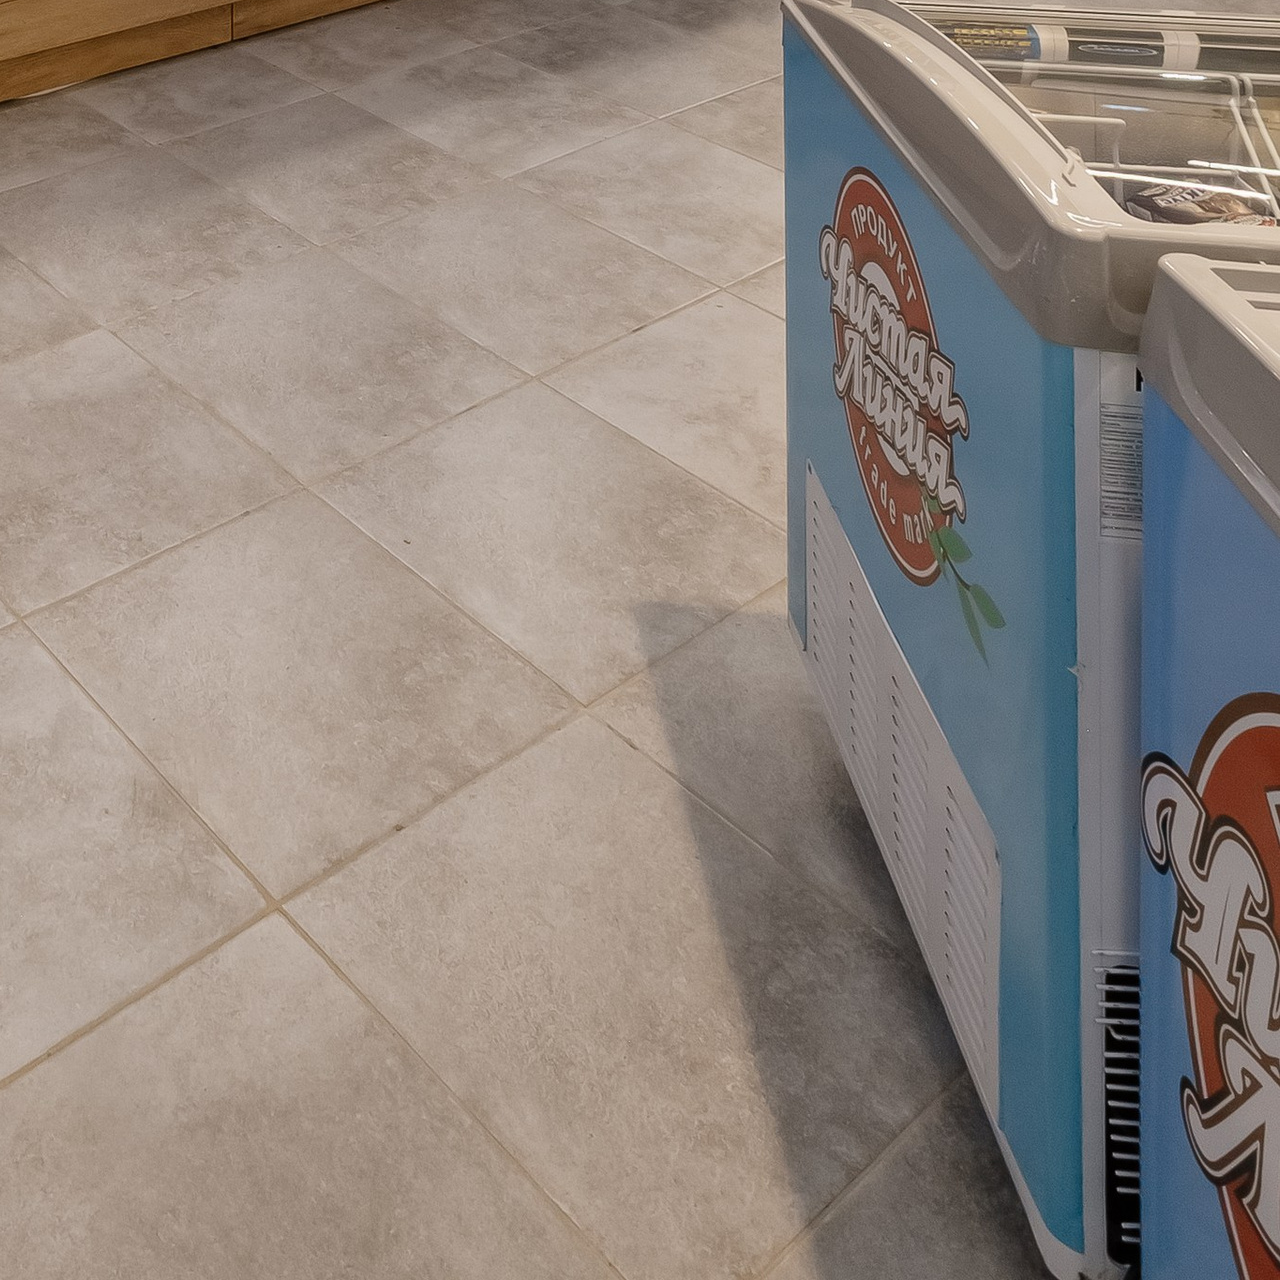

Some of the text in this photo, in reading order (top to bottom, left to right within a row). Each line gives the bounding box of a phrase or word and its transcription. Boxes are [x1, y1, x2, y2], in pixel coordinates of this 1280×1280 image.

[820, 226, 968, 439] Чистая
[850, 203, 917, 303] ПРОДУКТ
[833, 325, 966, 524] Линия
[859, 425, 935, 545] trade mark
